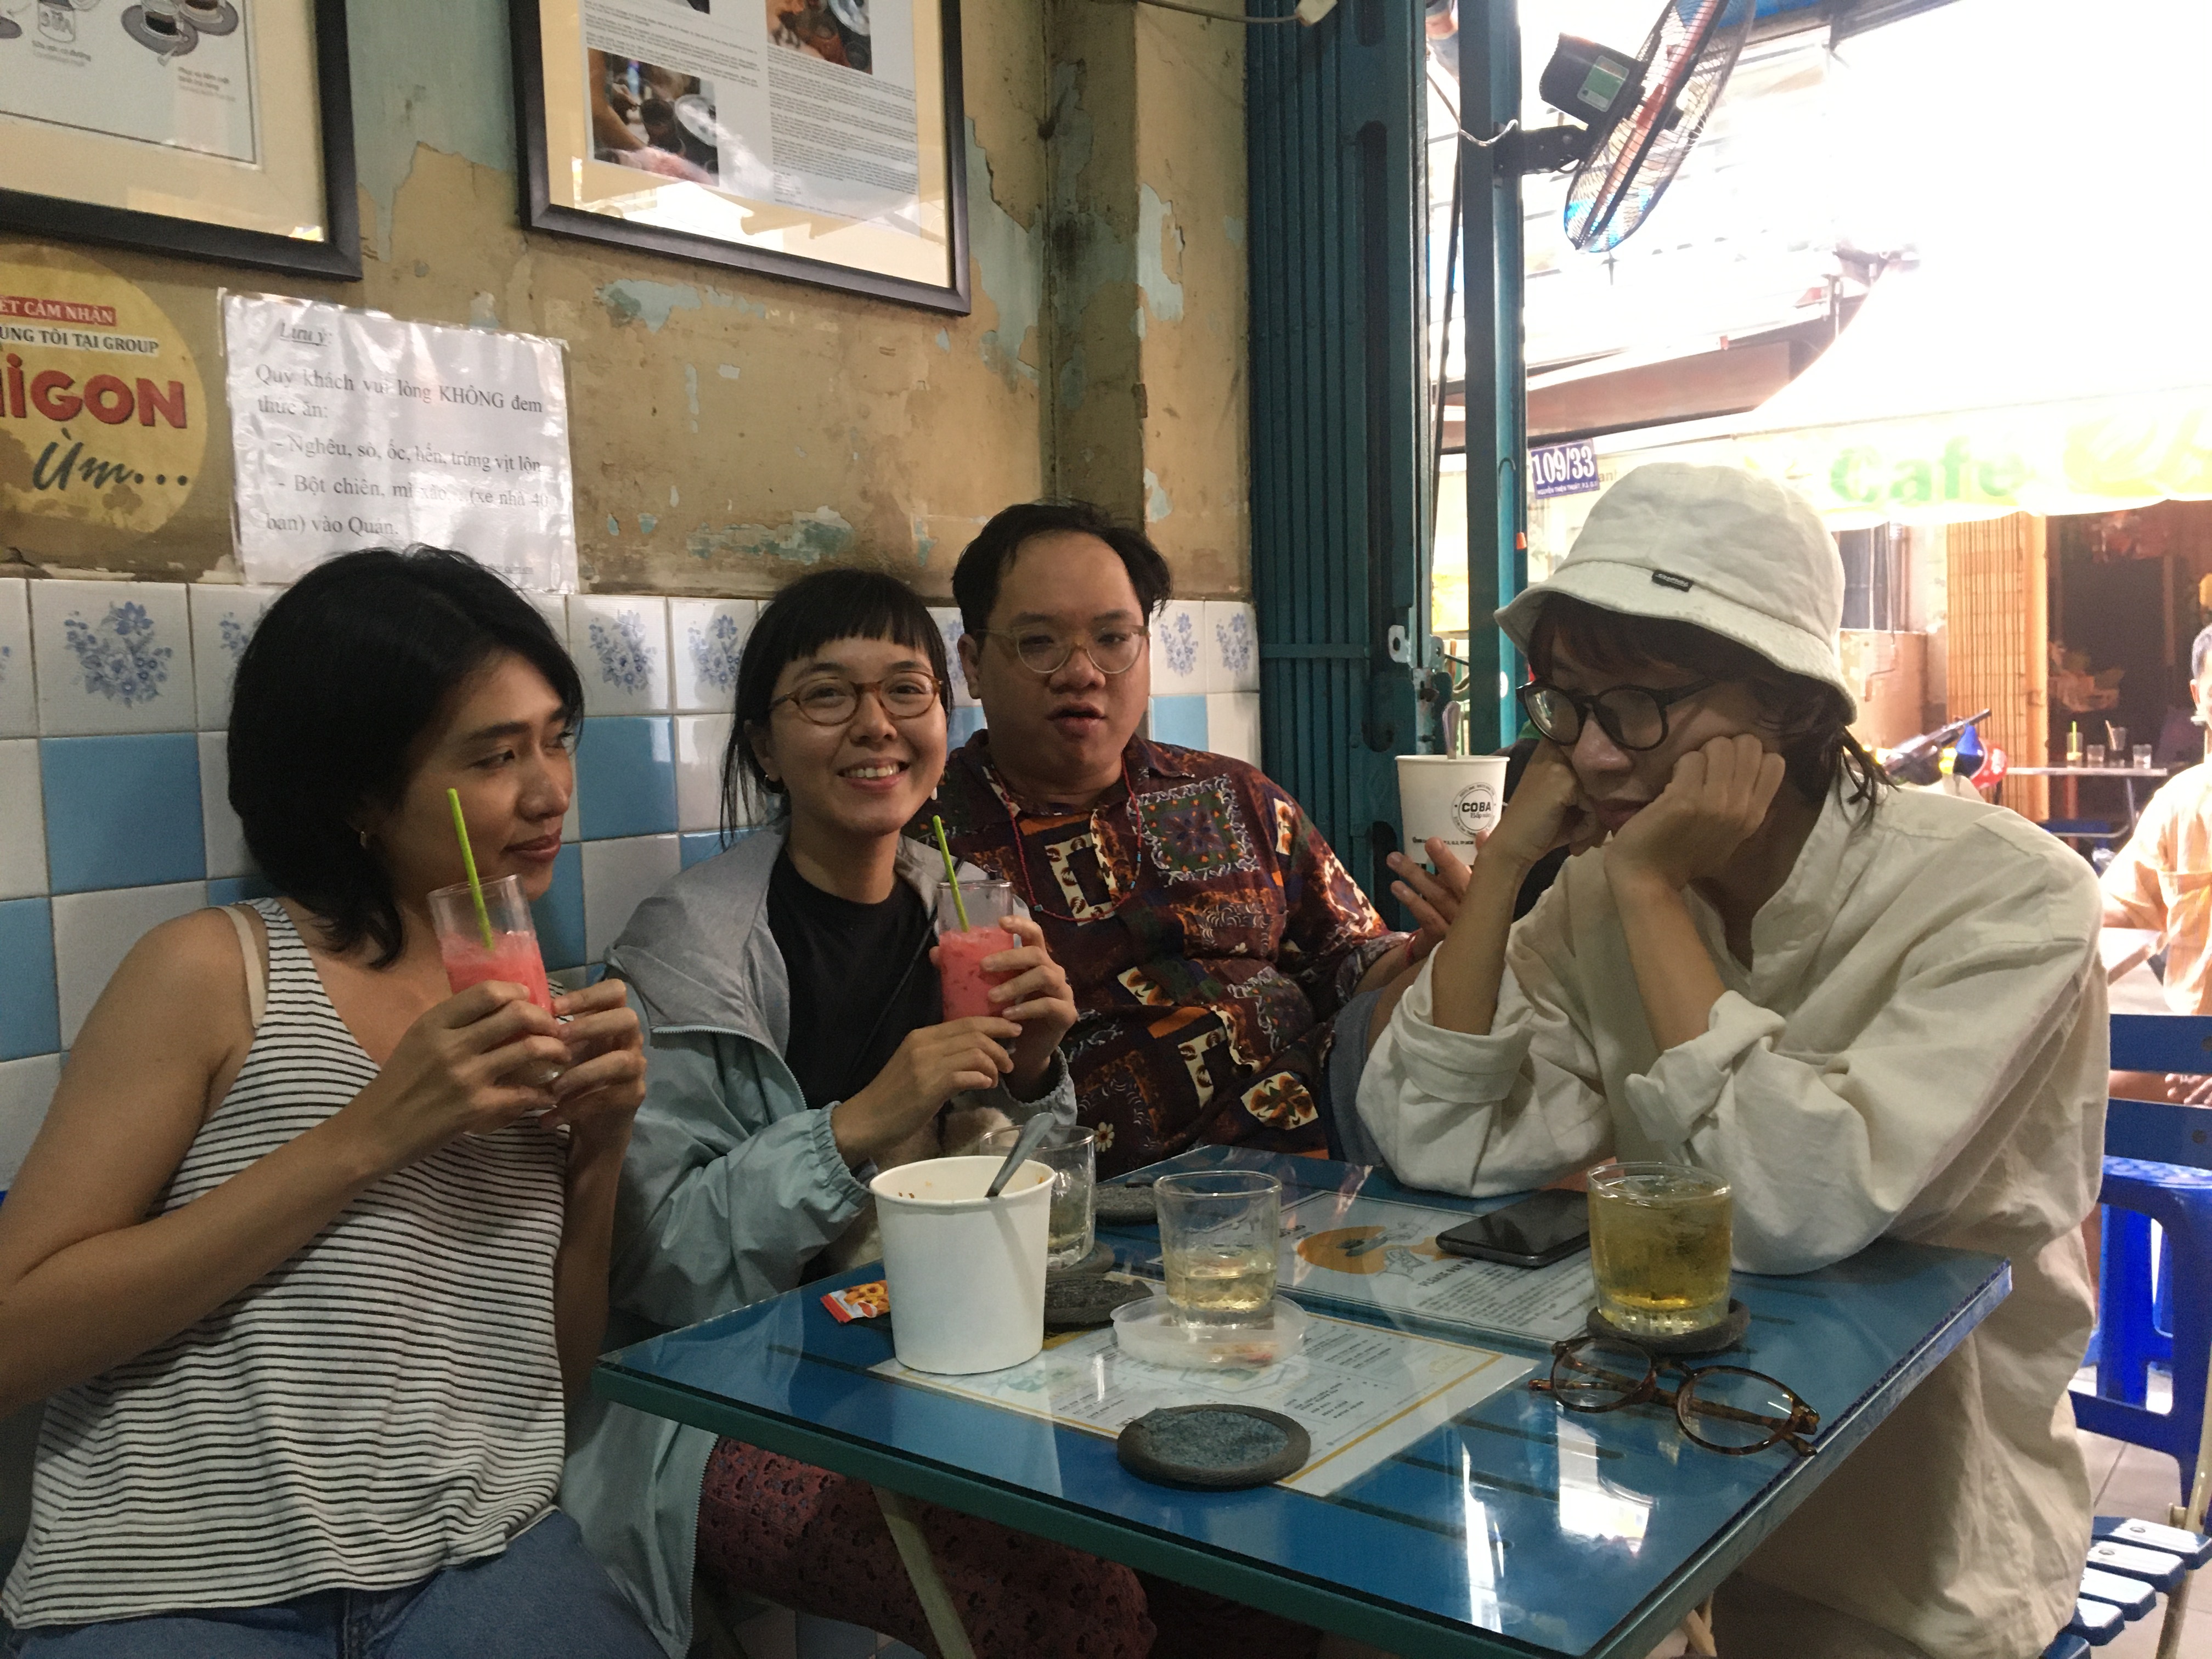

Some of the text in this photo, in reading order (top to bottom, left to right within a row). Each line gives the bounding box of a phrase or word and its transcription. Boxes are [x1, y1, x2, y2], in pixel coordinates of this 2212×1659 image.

[39, 328, 67, 345] TÔI
[103, 336, 159, 354] GROUP
[303, 369, 354, 391] khách
[398, 379, 432, 404] lòng
[438, 384, 504, 409] KHÔNG
[511, 394, 543, 413] đem
[287, 434, 352, 458] Nghêu,
[357, 442, 382, 461] sò,
[387, 438, 410, 463] ốc,
[452, 450, 490, 472] trứng
[495, 454, 515, 472] vịt
[1532, 445, 1595, 484] 109/33
[295, 475, 325, 496] Bột
[334, 477, 385, 498] chiên,
[393, 482, 413, 498] mì
[470, 486, 493, 507] (xe
[499, 489, 526, 506] nhà
[312, 515, 342, 532] vào
